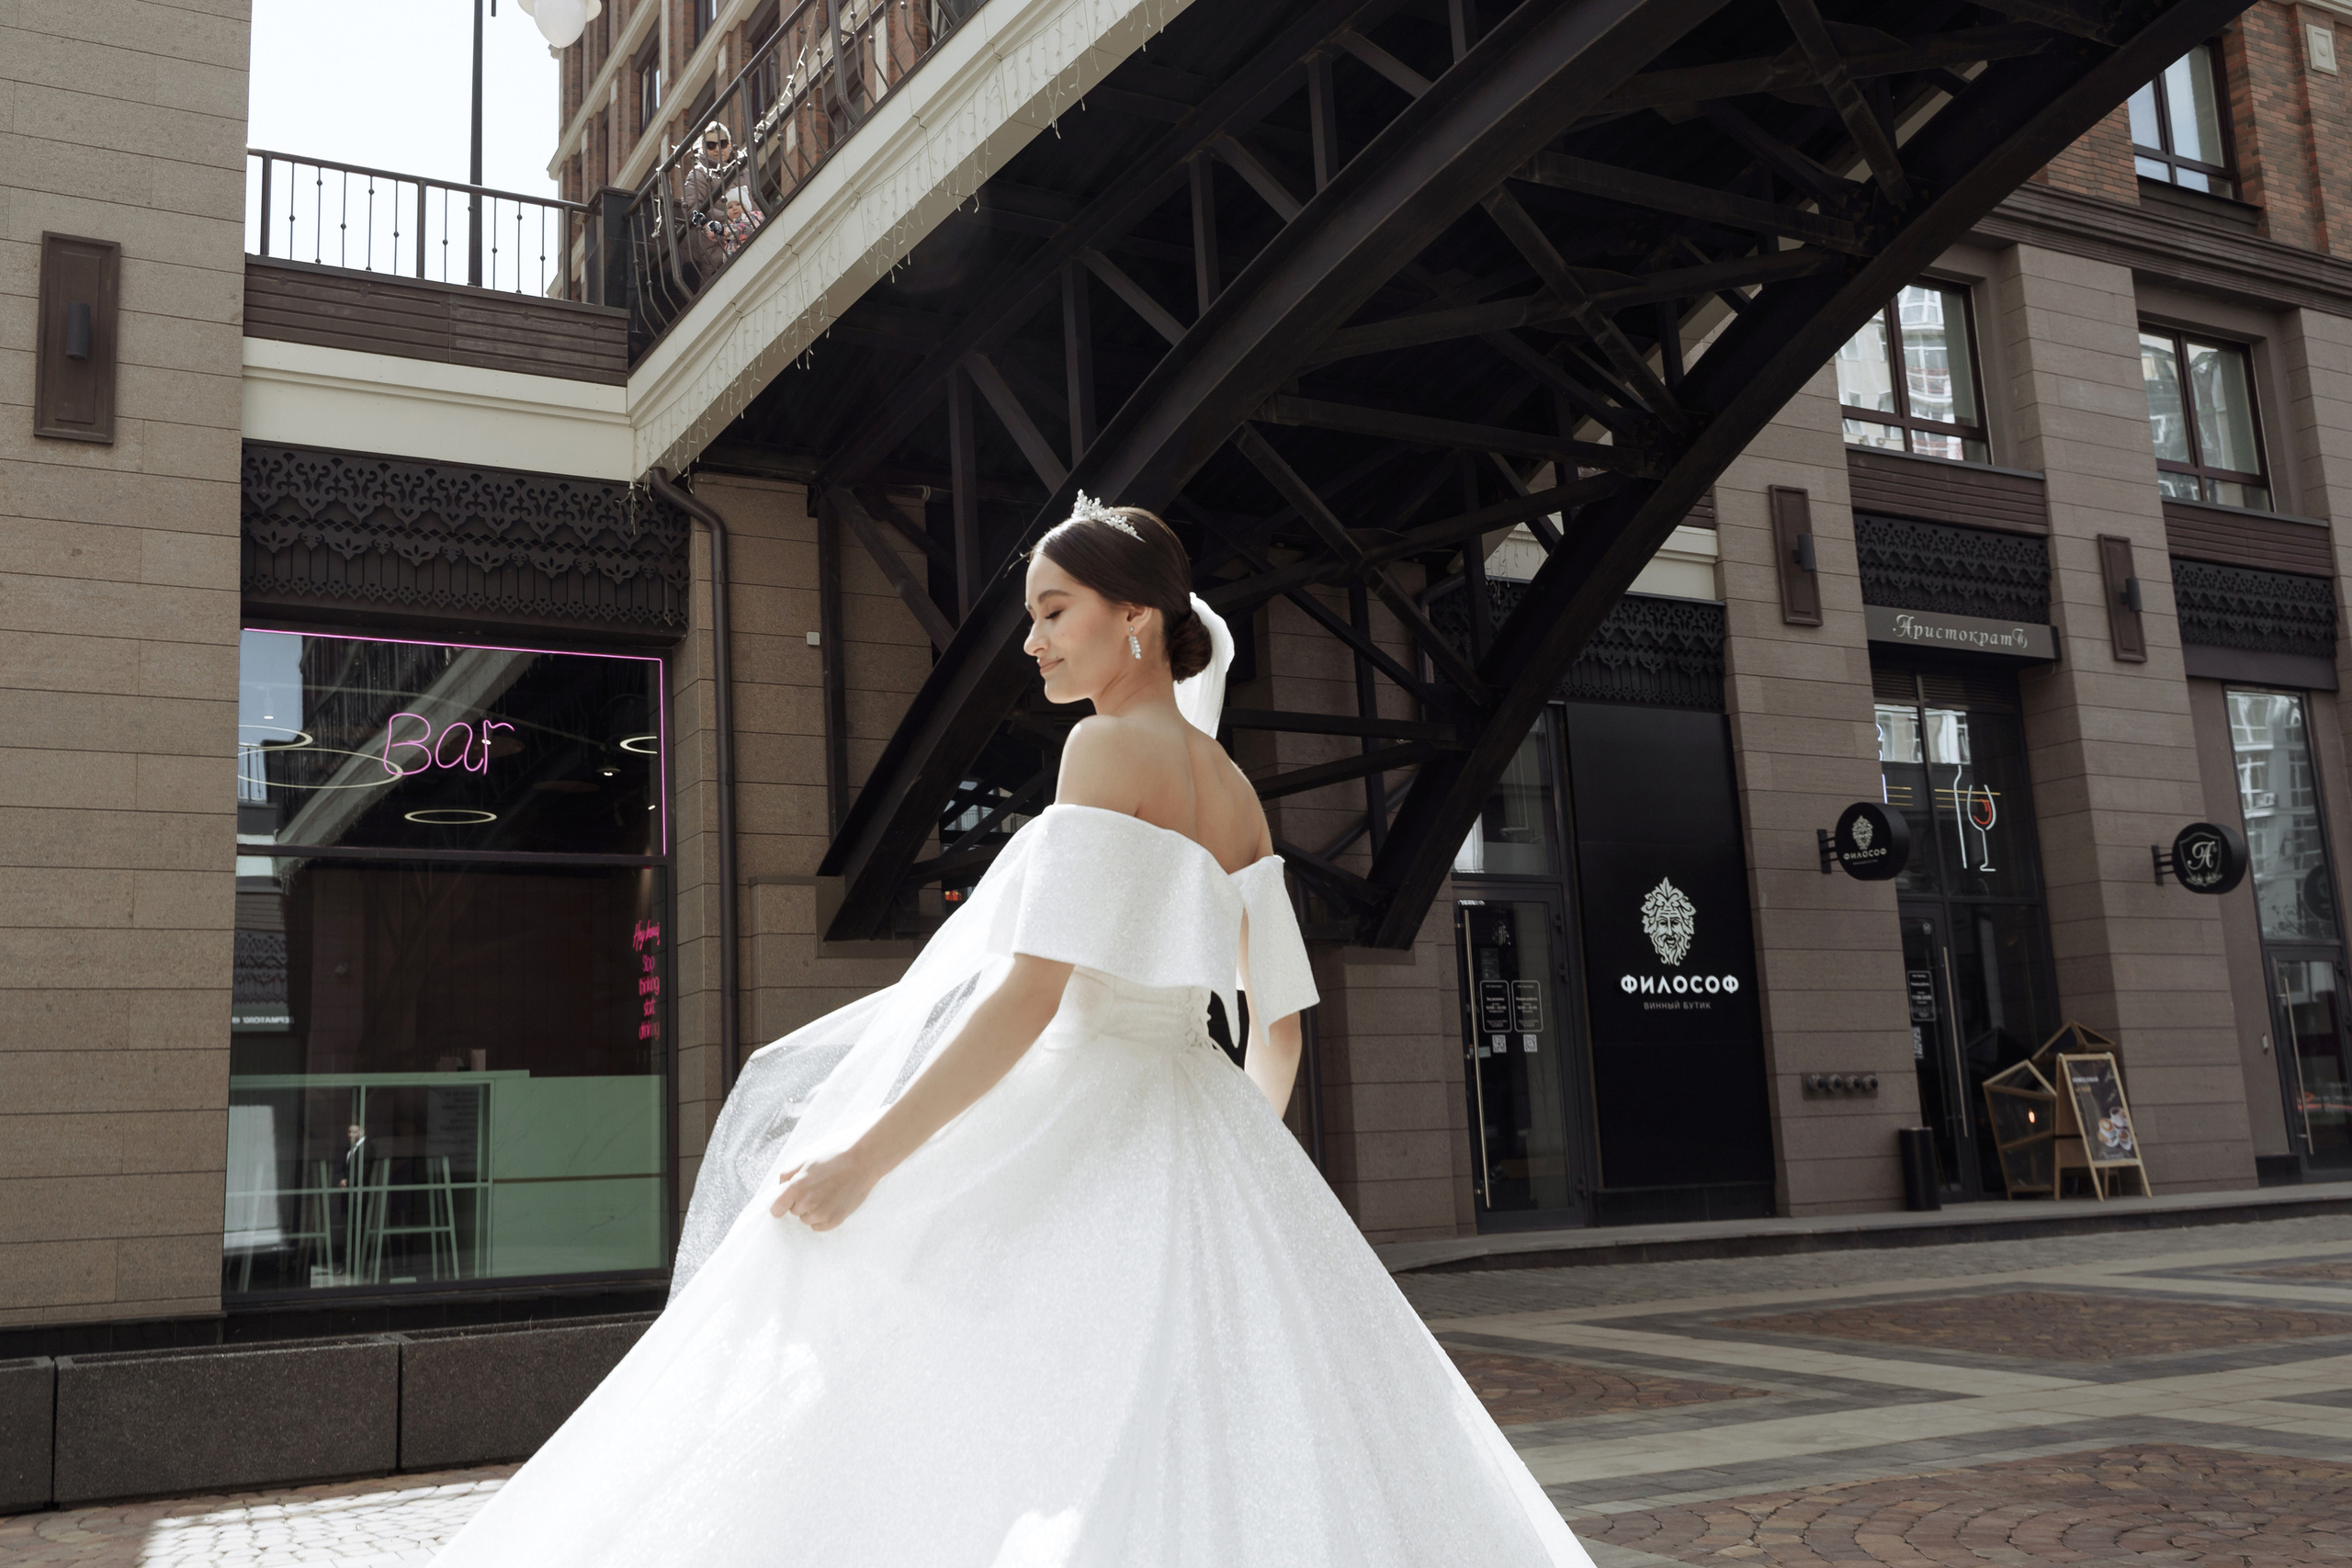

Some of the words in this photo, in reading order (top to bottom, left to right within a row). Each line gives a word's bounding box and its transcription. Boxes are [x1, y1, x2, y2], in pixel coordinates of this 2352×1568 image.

[383, 713, 514, 775] Bar
[1843, 847, 1887, 861] ФИЛОСОФ
[1620, 974, 1739, 995] ФИЛОСОФ
[1643, 1000, 1680, 1010] ВИННЫЙ
[1683, 1001, 1712, 1010] БУТИК
